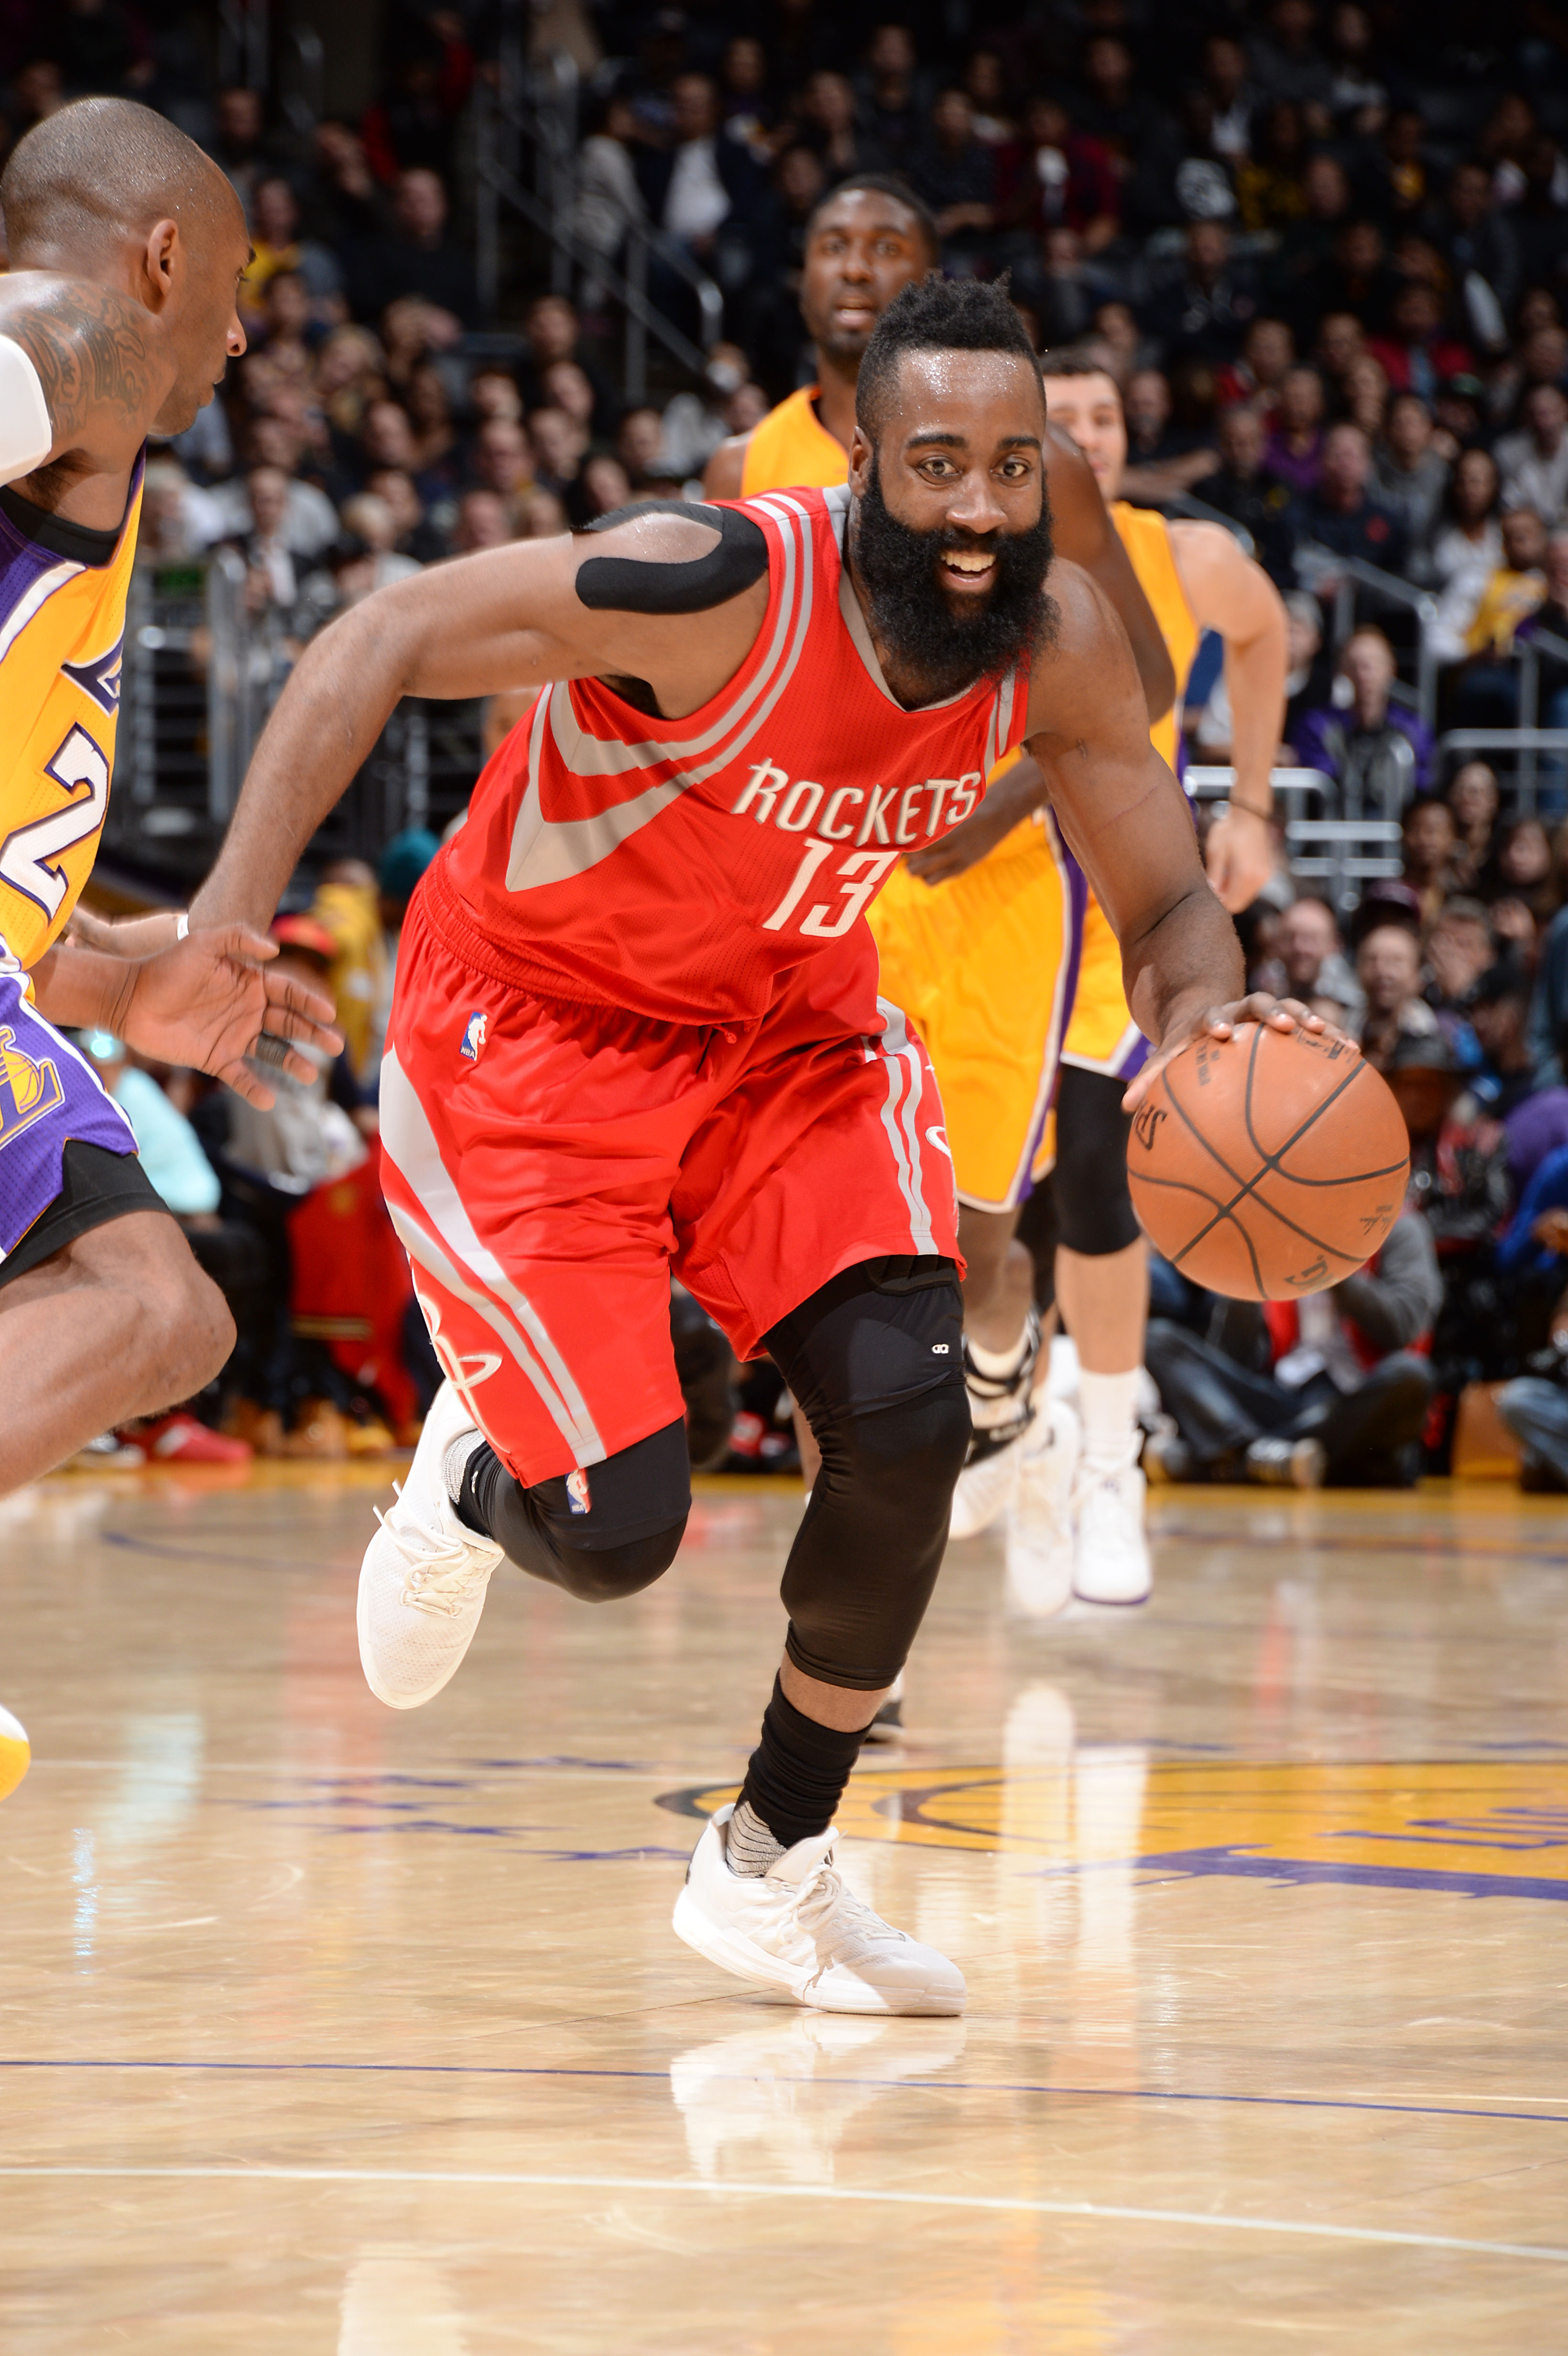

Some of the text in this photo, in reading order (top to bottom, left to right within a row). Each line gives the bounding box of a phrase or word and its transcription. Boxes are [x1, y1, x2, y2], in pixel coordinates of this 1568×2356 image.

[731, 757, 981, 848] ROCKETS
[762, 838, 900, 938] 13
[460, 1047, 475, 1058] NBA
